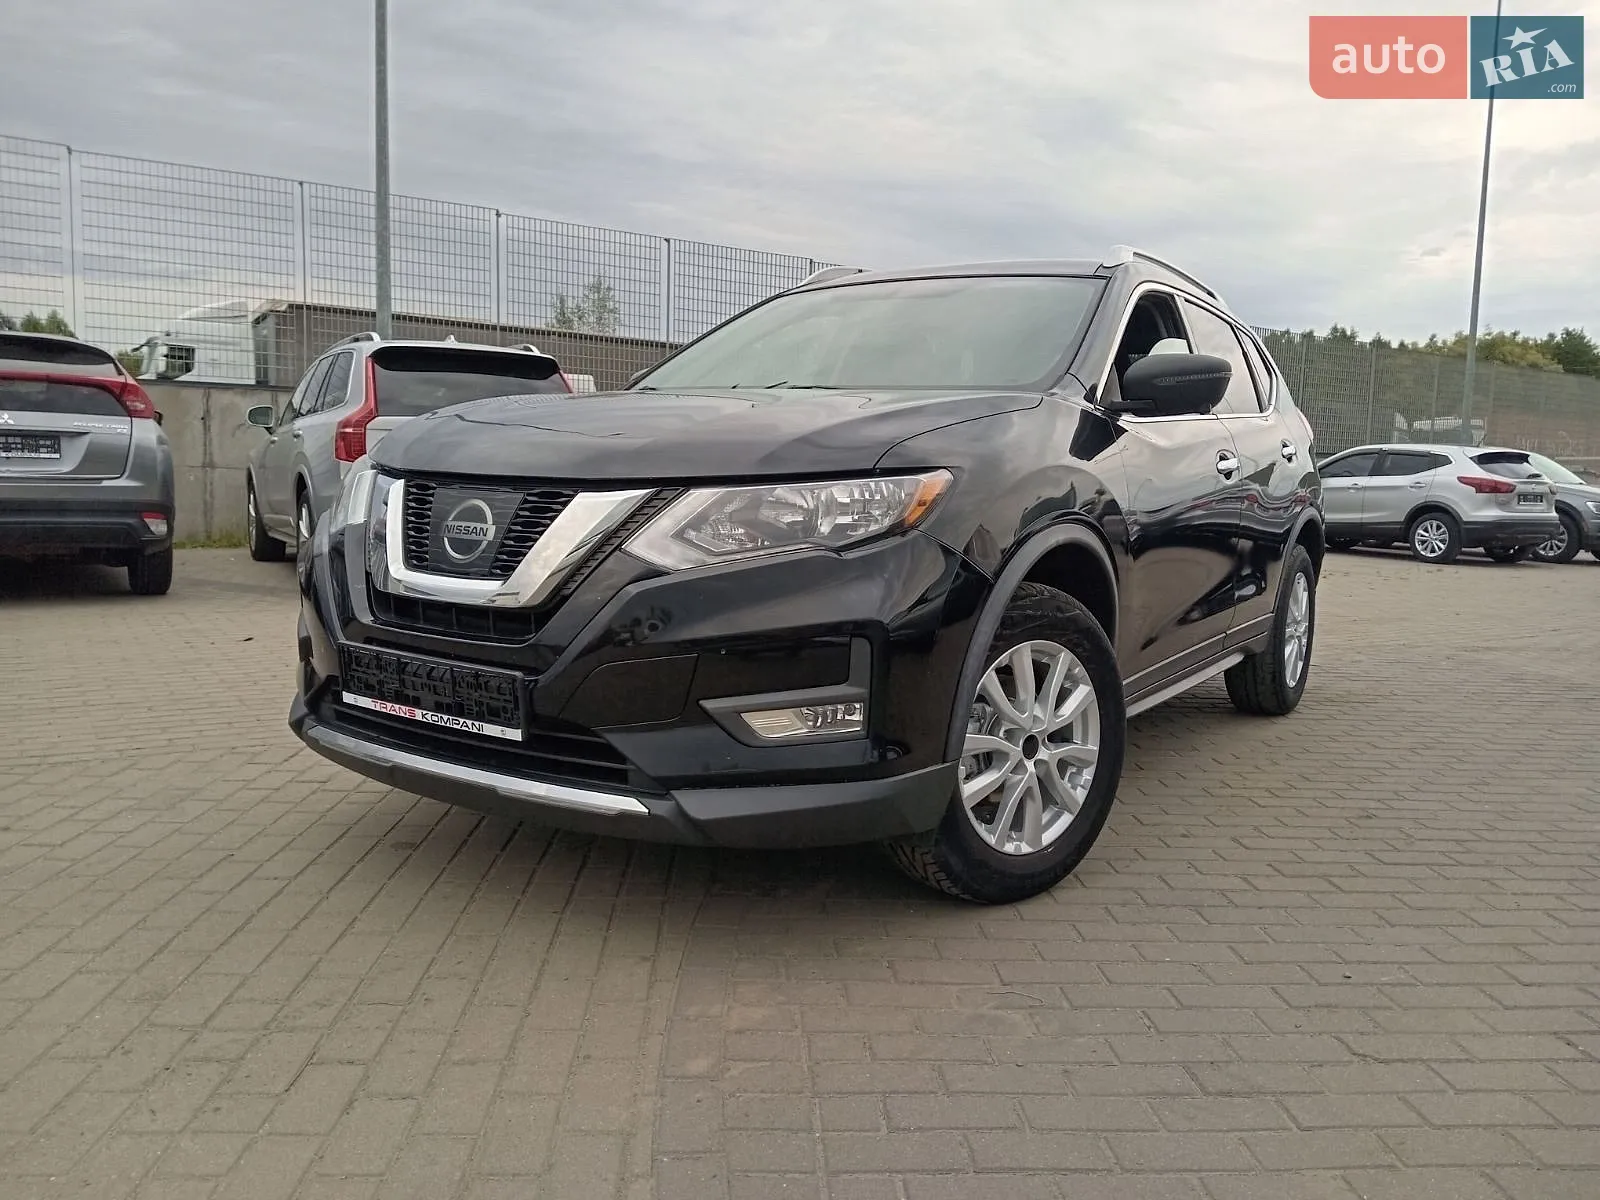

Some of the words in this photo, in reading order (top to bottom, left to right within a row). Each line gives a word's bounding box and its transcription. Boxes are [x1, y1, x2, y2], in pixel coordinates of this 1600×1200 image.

[443, 524, 489, 537] NISSAN
[371, 700, 417, 718] TRANS
[420, 711, 485, 733] KOMPANI
